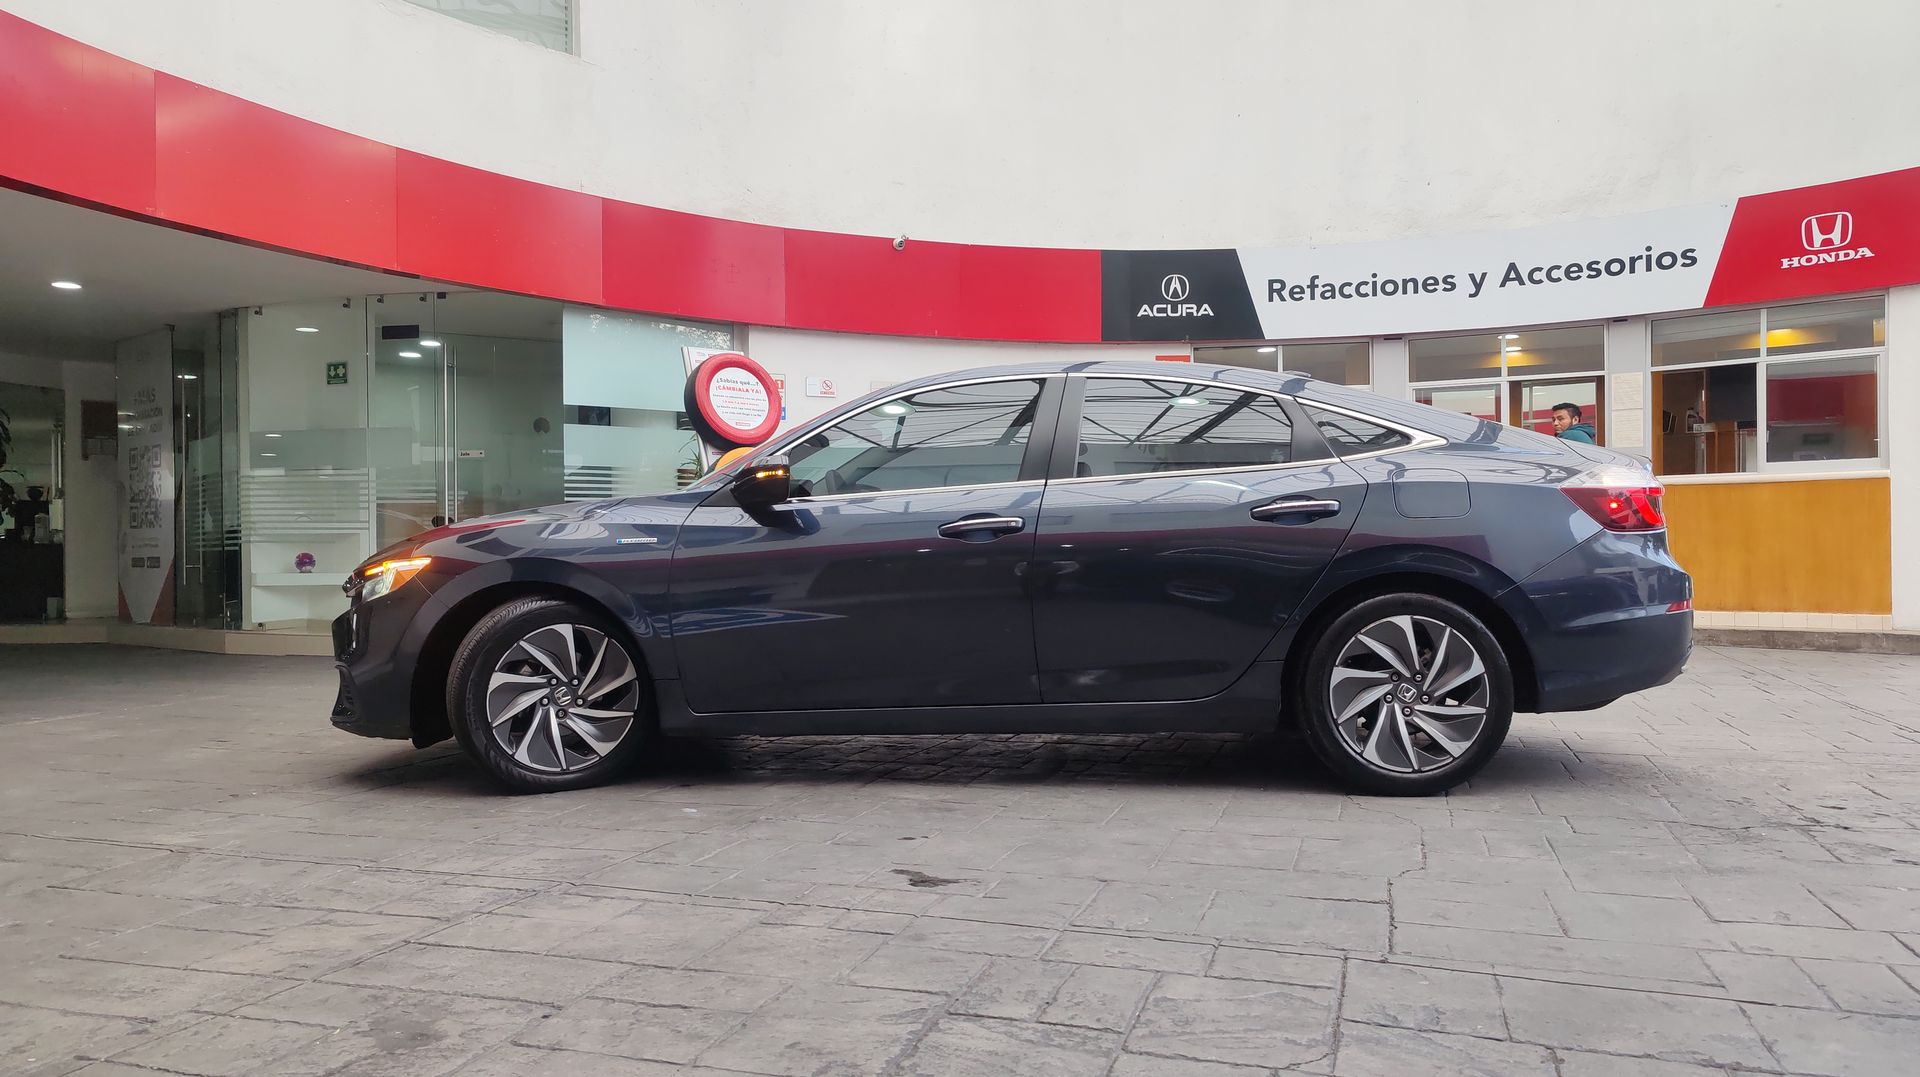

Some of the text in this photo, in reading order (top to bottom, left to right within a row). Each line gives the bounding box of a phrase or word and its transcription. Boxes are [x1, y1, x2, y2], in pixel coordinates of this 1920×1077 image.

[1780, 247, 1875, 269] HONDA
[1267, 245, 1698, 303] Refacciones y Accesorios
[1137, 303, 1215, 317] ACURA
